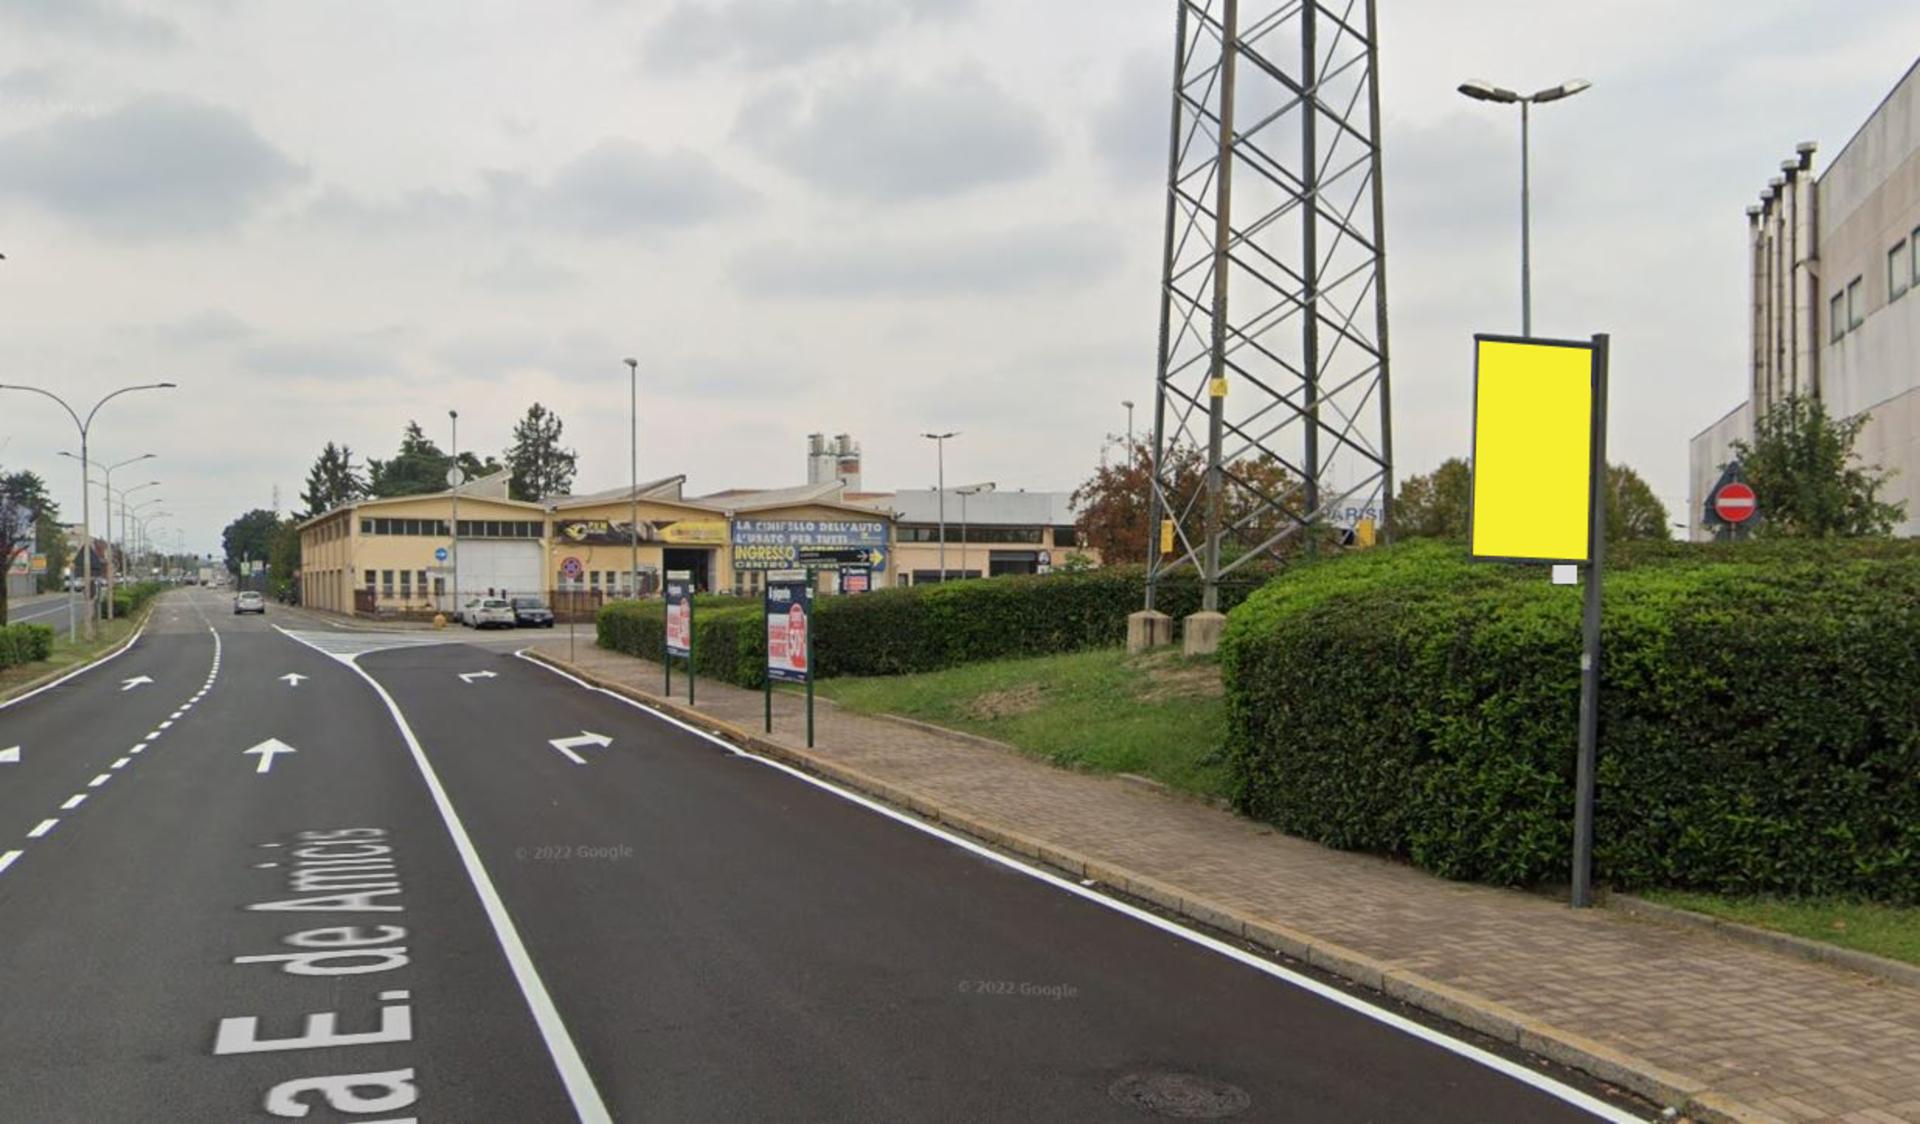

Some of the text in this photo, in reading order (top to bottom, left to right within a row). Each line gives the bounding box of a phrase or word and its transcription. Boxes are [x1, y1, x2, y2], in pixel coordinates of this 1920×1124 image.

[736, 521, 751, 530] LA
[819, 522, 882, 532] DELL'AUTO
[790, 534, 812, 545] PER
[735, 546, 795, 561] INGRESSO
[243, 828, 405, 912] Amicis
[233, 925, 410, 976] de
[214, 990, 412, 1055] E.
